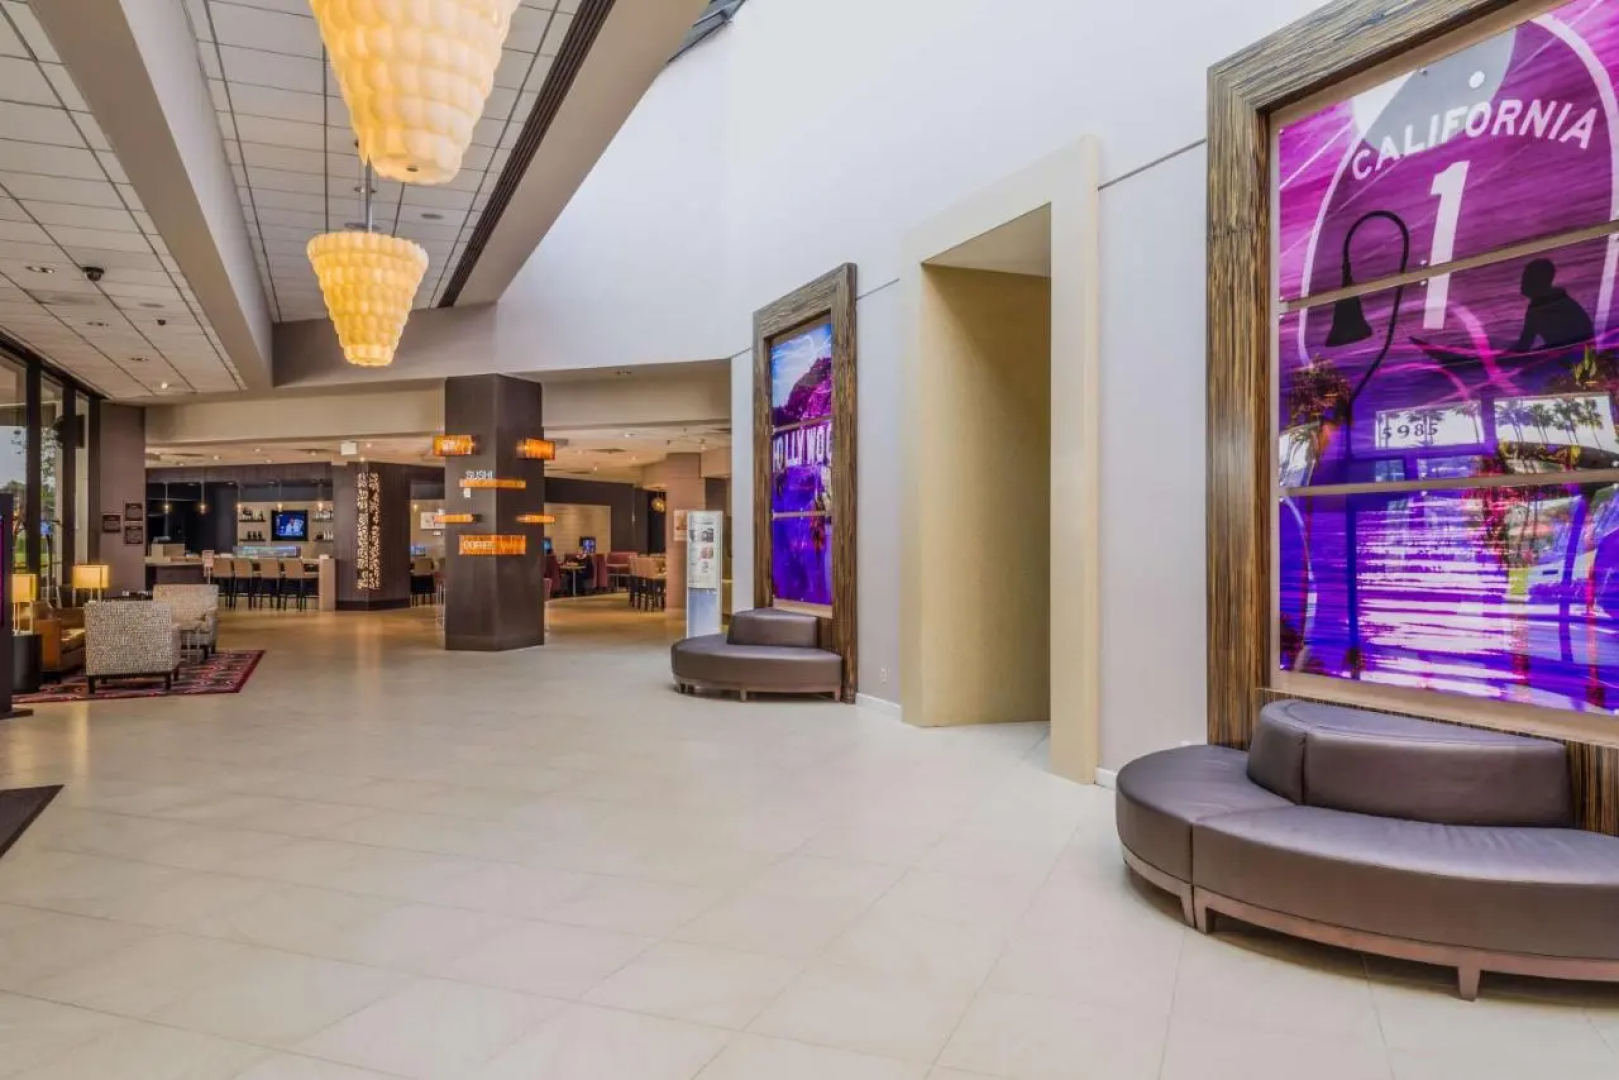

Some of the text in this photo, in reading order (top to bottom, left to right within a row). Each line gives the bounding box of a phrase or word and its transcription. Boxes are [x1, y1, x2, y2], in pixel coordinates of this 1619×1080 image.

[1352, 98, 1598, 181] CALIFORNIA
[1423, 160, 1470, 330] 1
[465, 469, 493, 479] SUSHI
